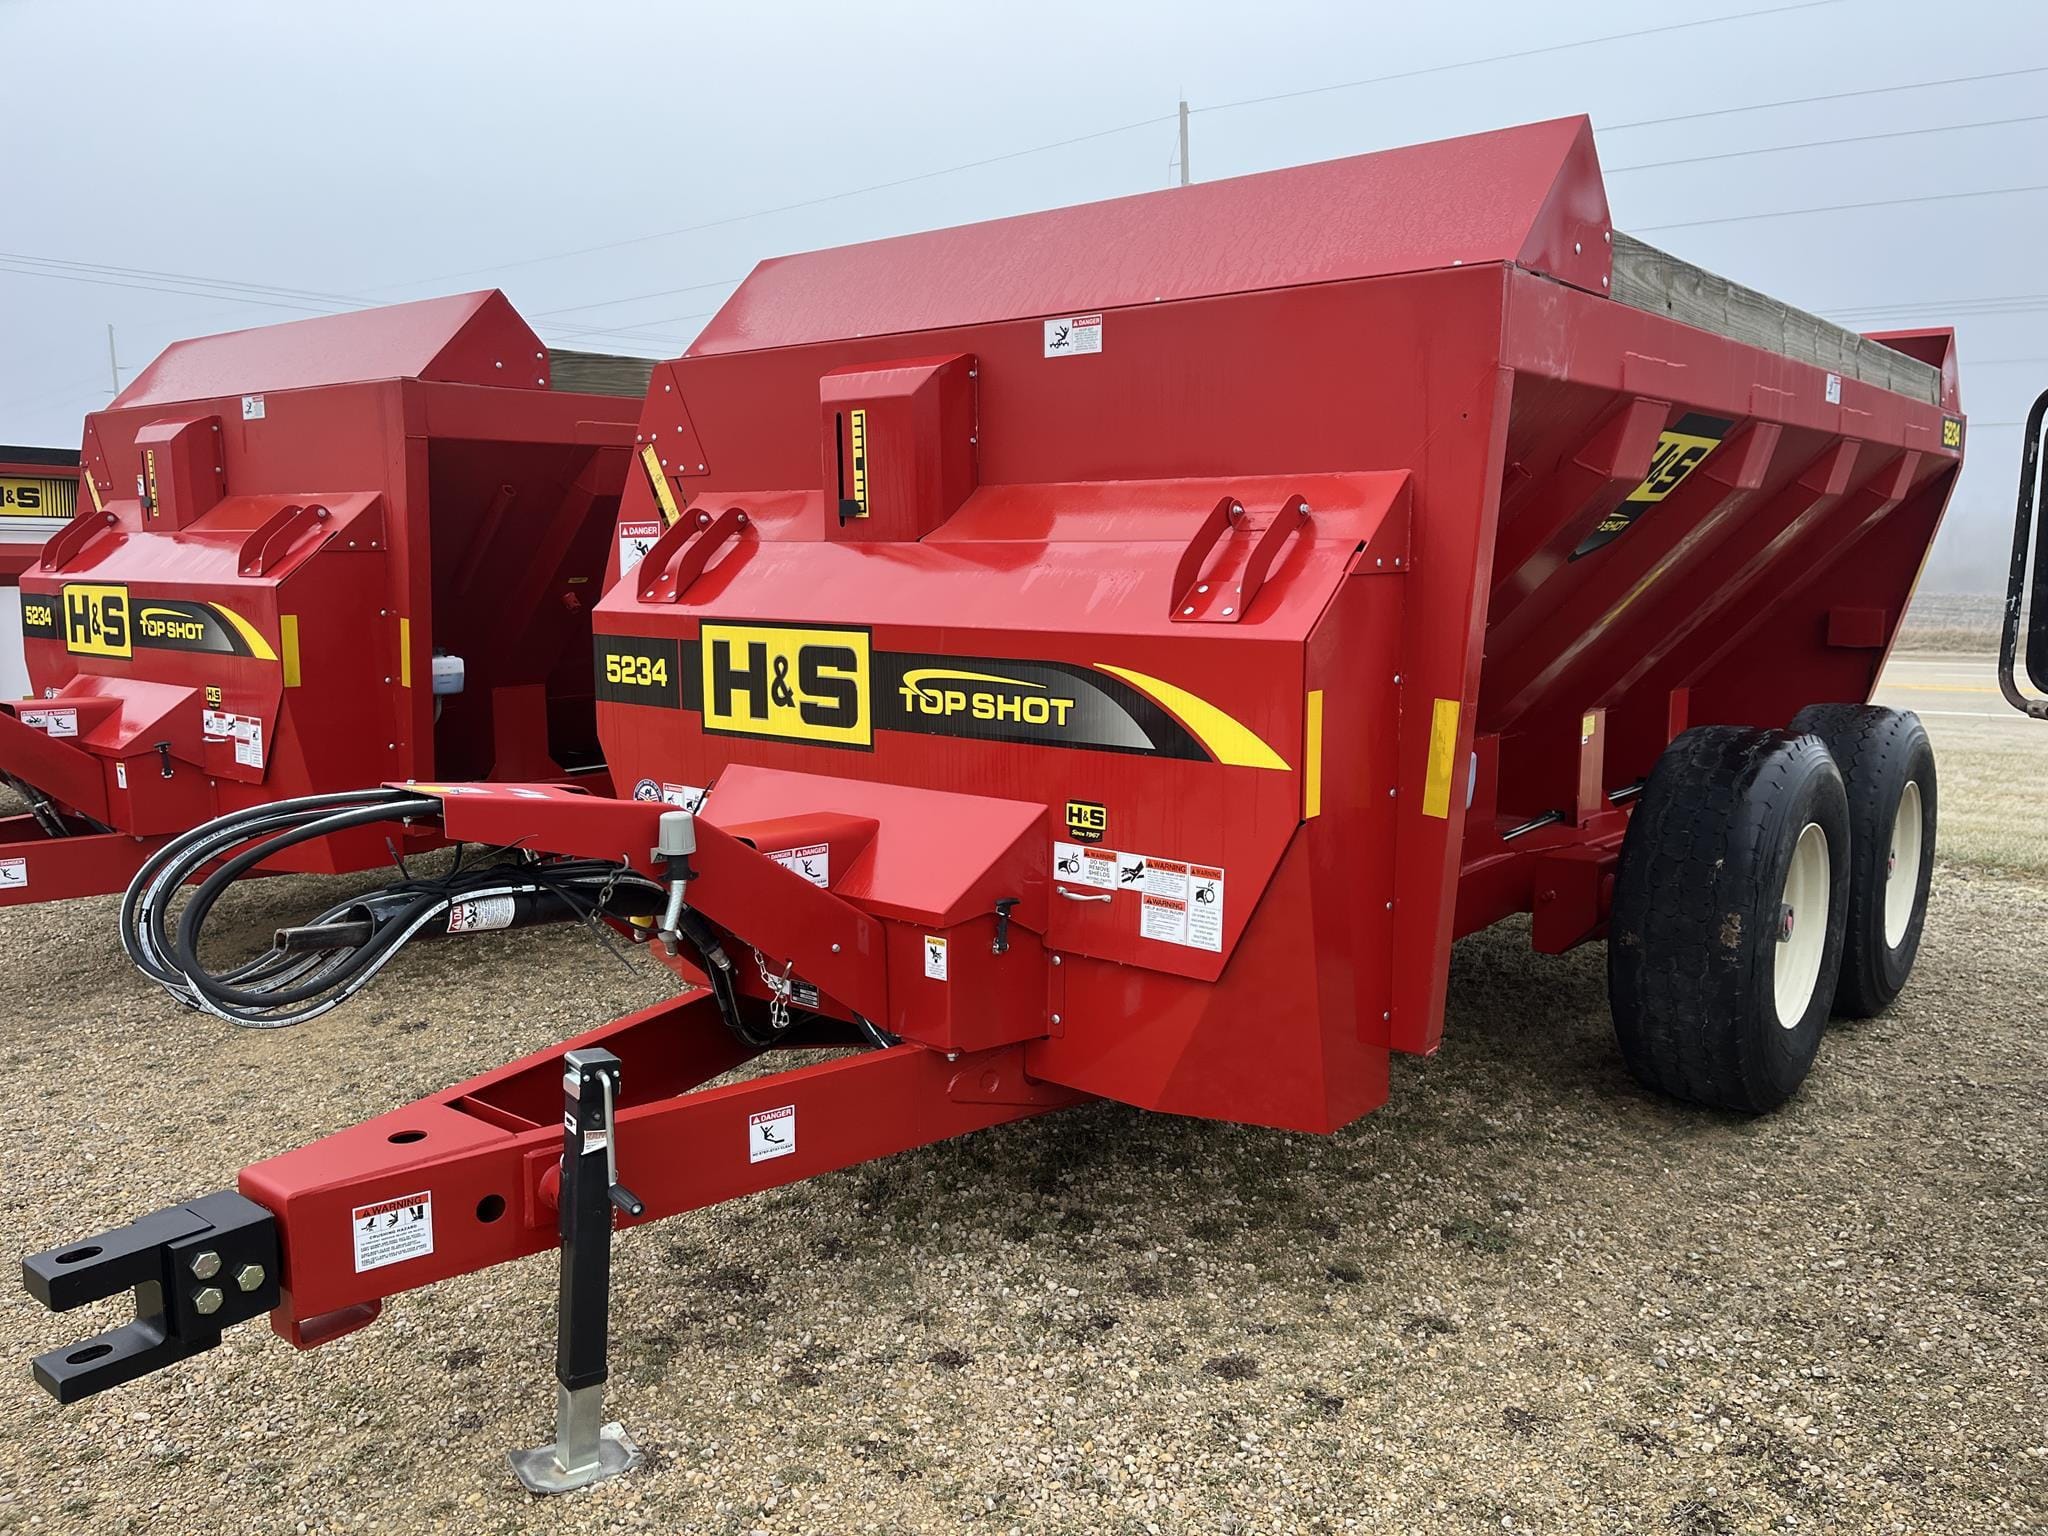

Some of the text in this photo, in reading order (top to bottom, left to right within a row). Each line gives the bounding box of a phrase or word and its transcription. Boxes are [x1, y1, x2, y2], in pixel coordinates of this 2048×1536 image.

[1078, 318, 1100, 326] DANGER
[0, 486, 40, 508] &S
[629, 526, 658, 535] DANGER
[25, 606, 52, 626] 5234
[67, 594, 126, 647] H&S
[140, 619, 204, 640] TOP SHOT
[606, 654, 668, 687] 5234
[711, 638, 858, 729] H&S
[898, 687, 1075, 726] TOP SHOT
[1068, 806, 1105, 827] H&S
[802, 846, 826, 856] DANGER
[1154, 860, 1186, 873] WARNING
[1196, 868, 1222, 878] WARNING
[1152, 898, 1183, 911] WARNING
[760, 1109, 792, 1122] DANGER
[371, 1195, 422, 1216] WARNING
